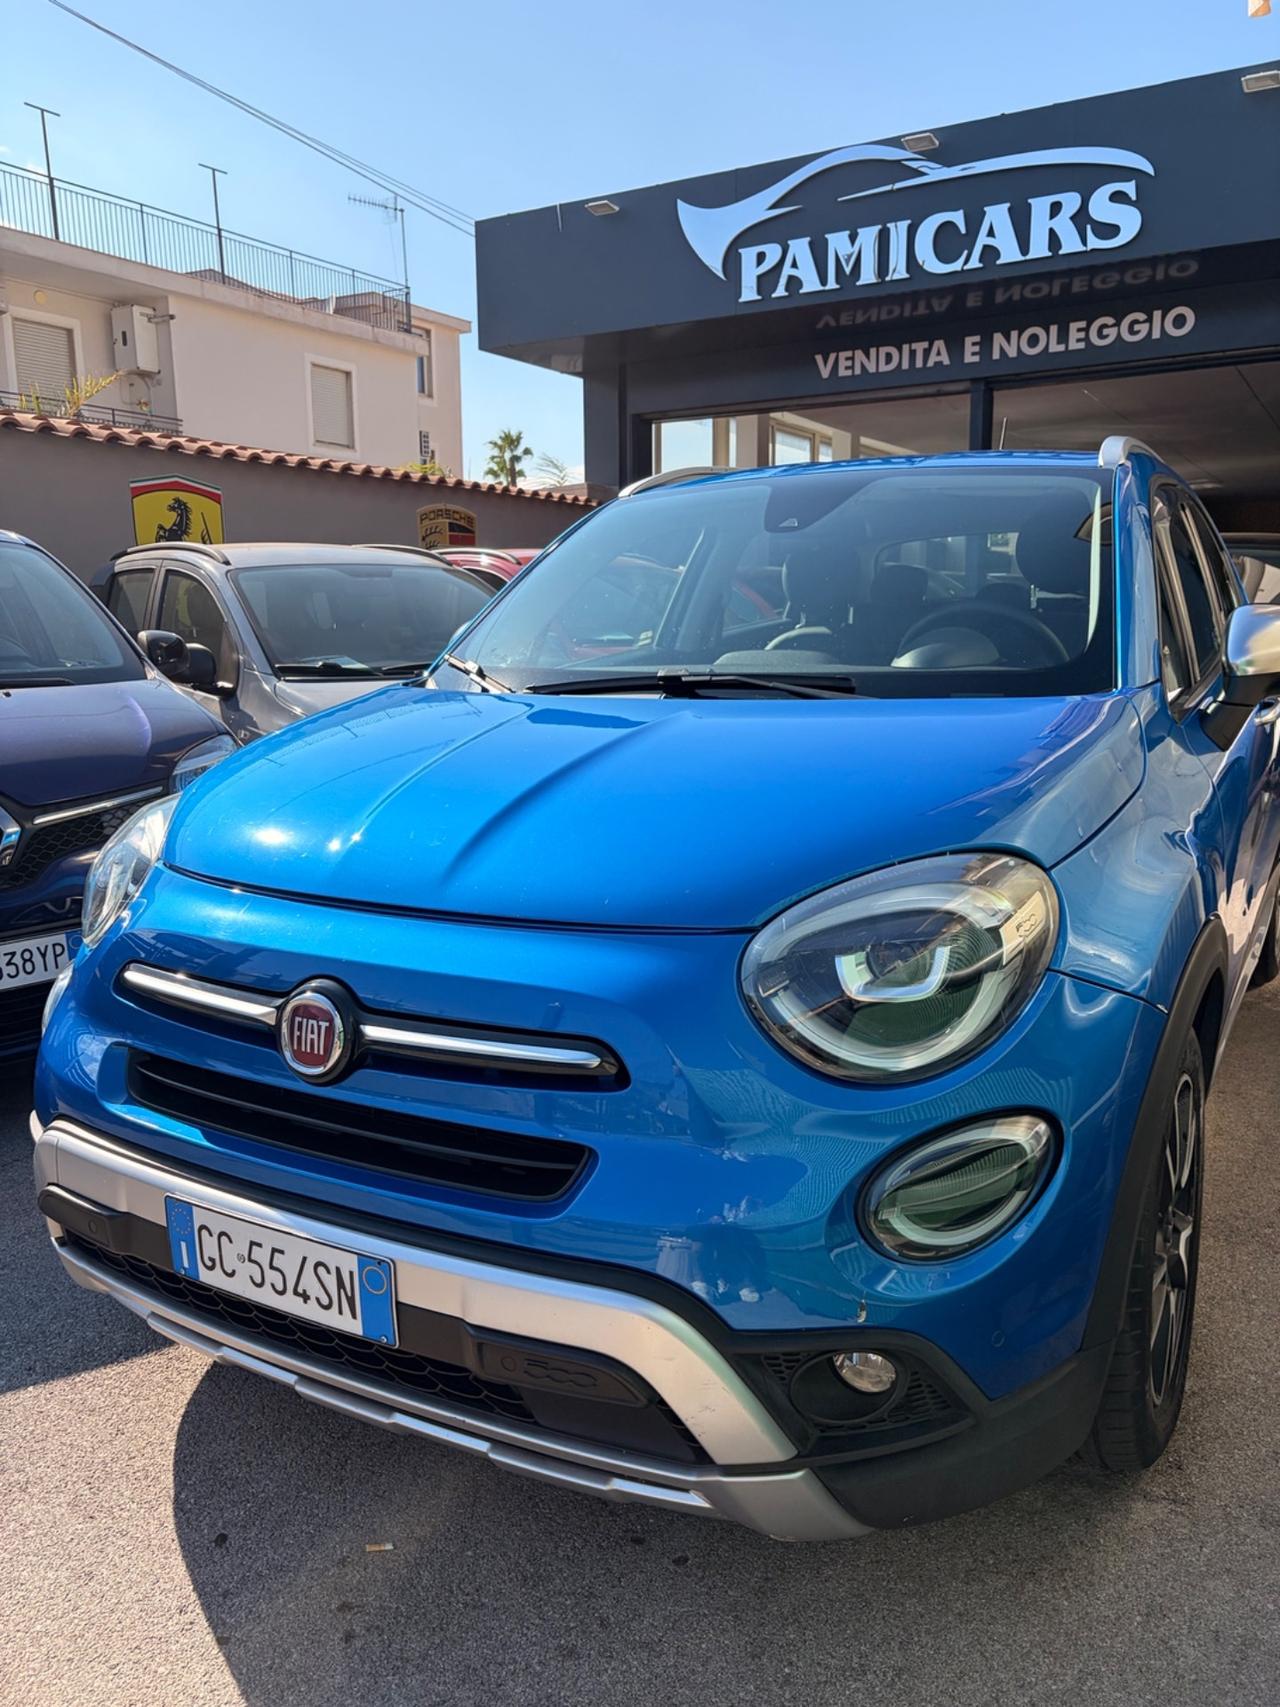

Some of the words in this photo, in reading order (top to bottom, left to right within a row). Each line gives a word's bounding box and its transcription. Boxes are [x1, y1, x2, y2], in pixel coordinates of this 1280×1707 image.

[738, 180, 1144, 303] PAMICARS
[814, 340, 951, 380] VENDITA
[963, 335, 982, 364] E
[991, 305, 1196, 361] NOLEGGIO
[420, 509, 474, 529] PORSCHE
[0, 942, 66, 979] 38YP
[293, 1016, 329, 1056] FIAT
